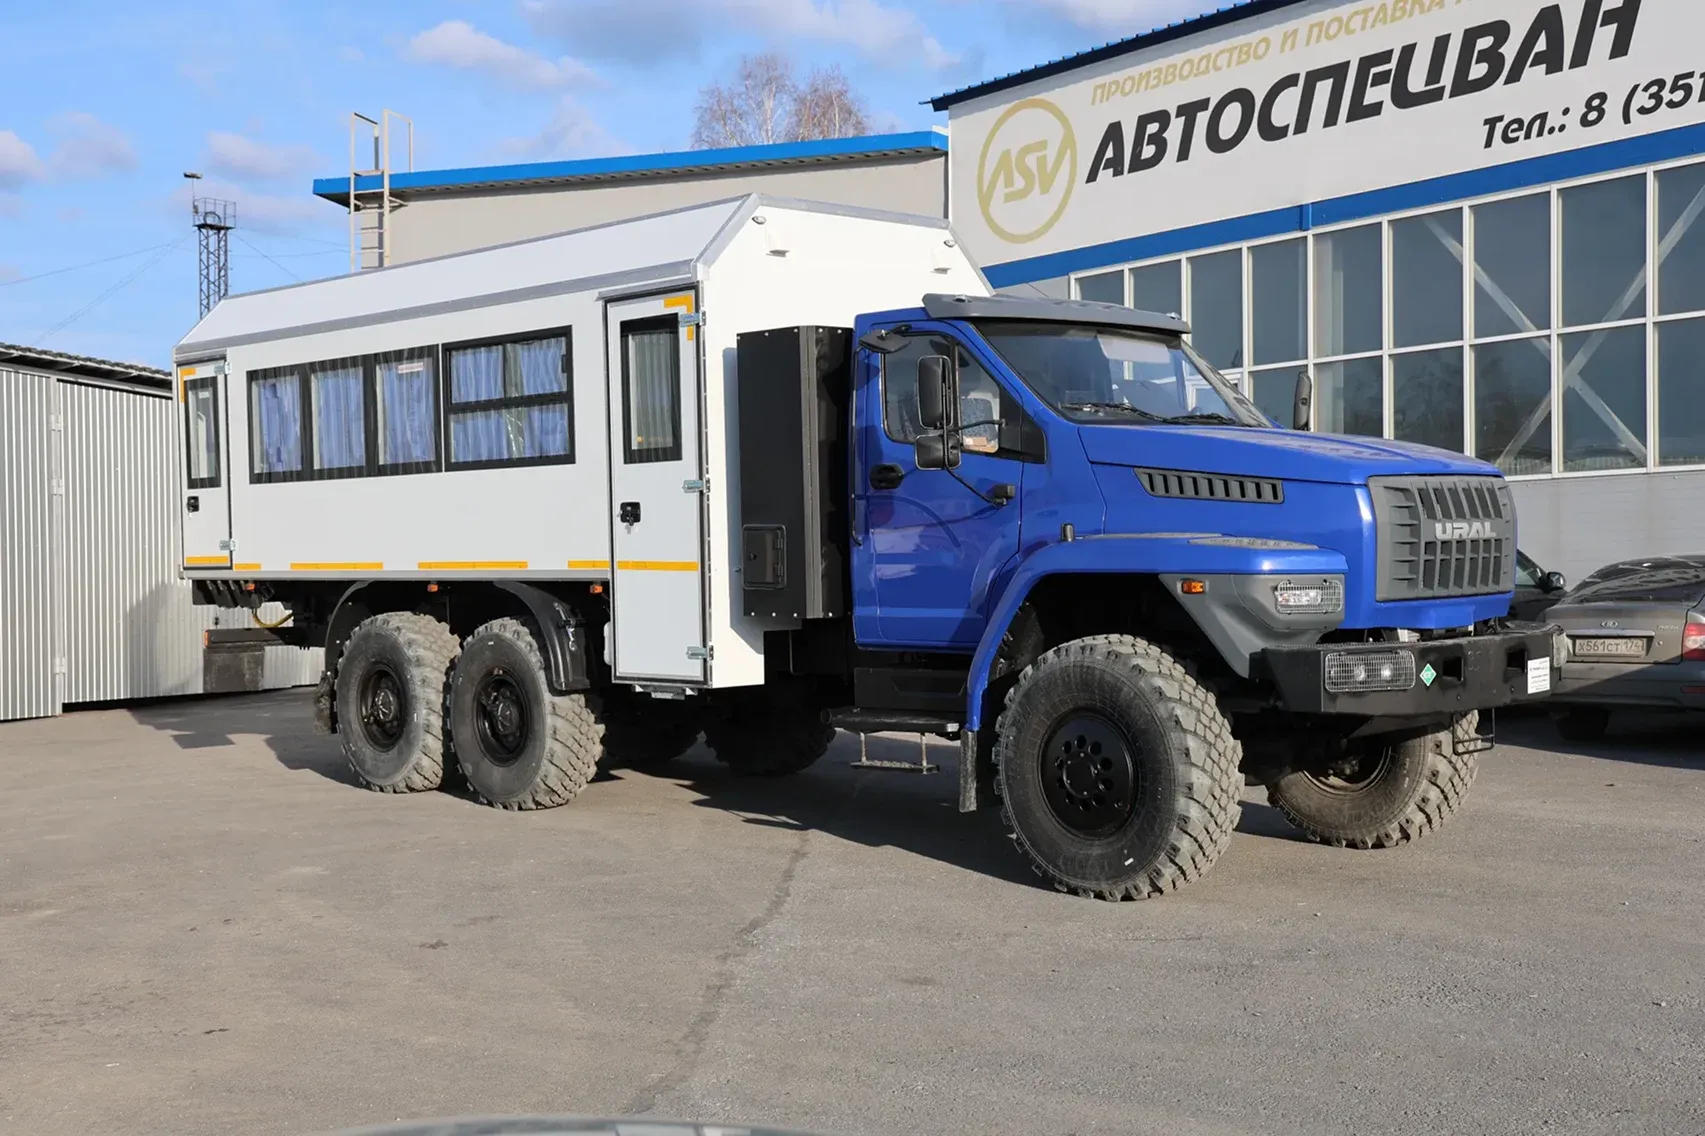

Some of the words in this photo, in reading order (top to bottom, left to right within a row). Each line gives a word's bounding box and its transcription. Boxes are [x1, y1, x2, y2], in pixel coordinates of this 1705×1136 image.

[1085, 0, 1642, 184] АВТОСПЕЦВАН
[1090, 36, 1272, 106] ПРОИЗВОДСТВО
[1280, 27, 1300, 54] И
[1483, 106, 1571, 149] Тел.:
[1579, 91, 1609, 128] 8
[984, 133, 1070, 205] ASV
[1435, 521, 1497, 540] URAL
